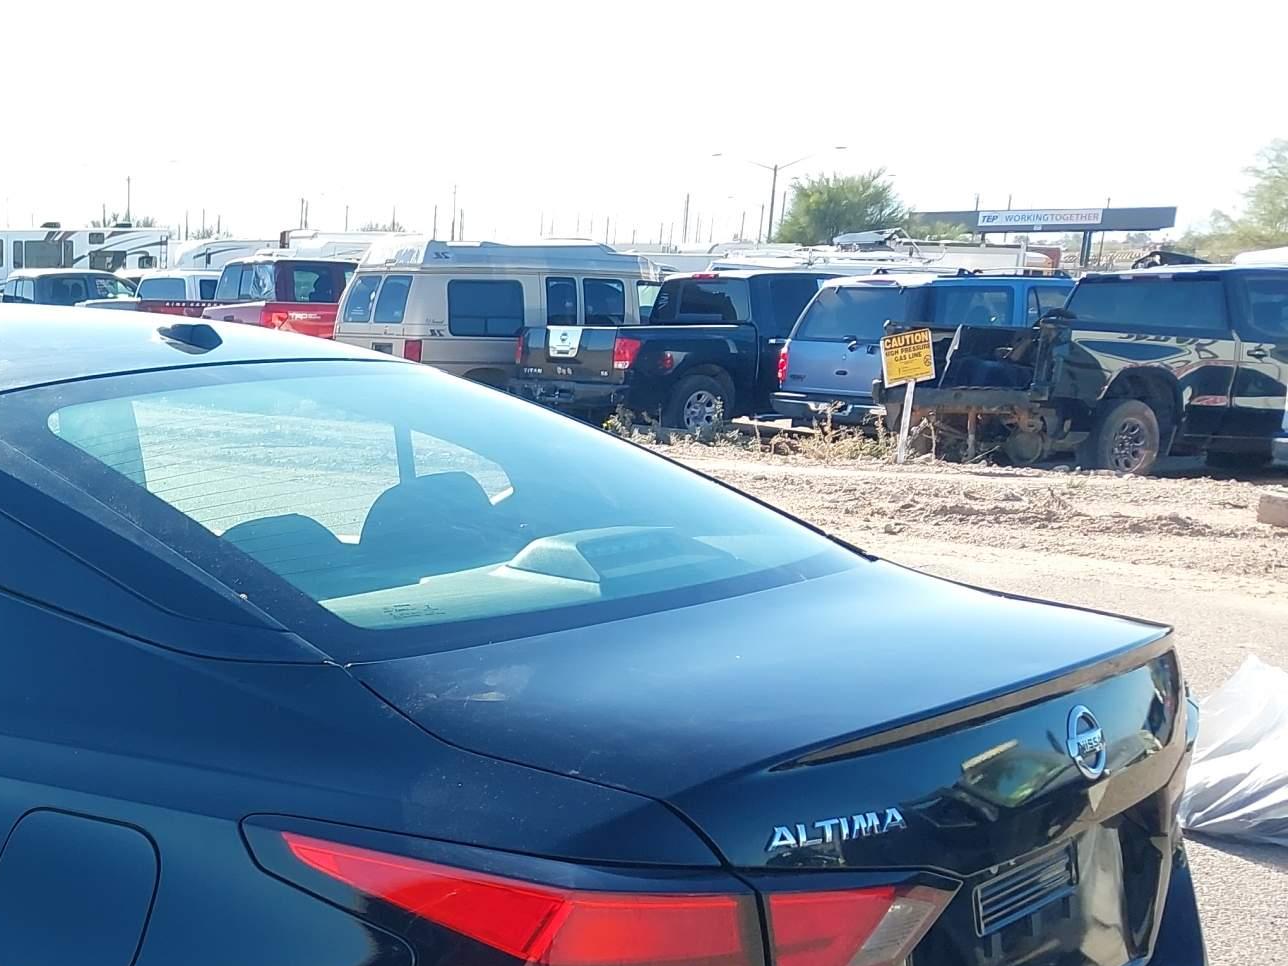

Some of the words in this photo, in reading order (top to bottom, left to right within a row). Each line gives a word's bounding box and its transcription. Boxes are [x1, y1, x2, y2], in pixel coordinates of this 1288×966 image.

[982, 215, 999, 223] TEP
[884, 331, 928, 348] CAUTION
[909, 351, 923, 359] LINE
[765, 807, 907, 852] ALTIMA
